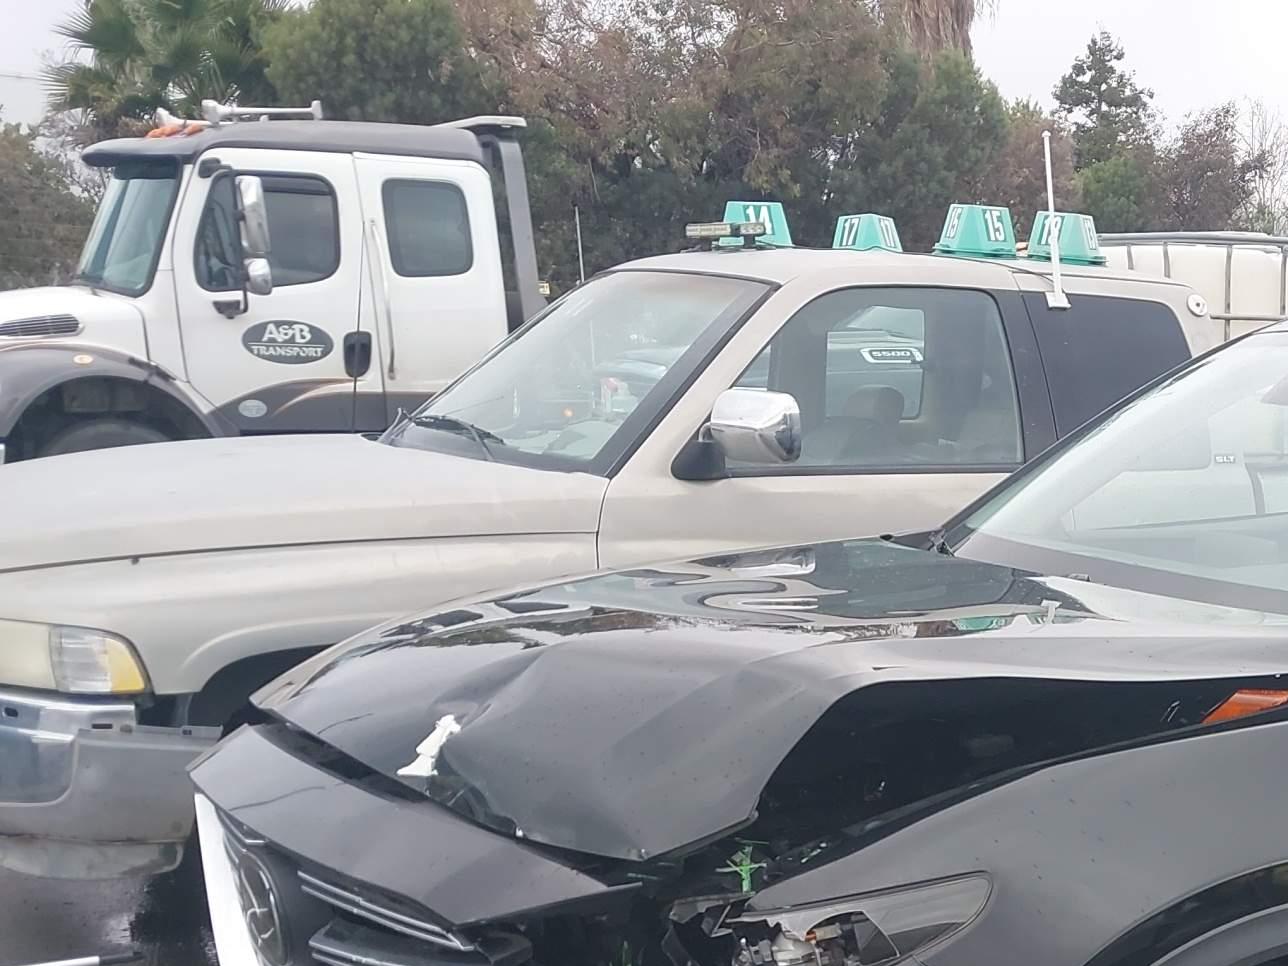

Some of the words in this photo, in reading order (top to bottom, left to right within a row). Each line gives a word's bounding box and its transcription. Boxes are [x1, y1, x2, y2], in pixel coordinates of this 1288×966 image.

[842, 217, 860, 247] 17
[984, 210, 1005, 242] 15
[261, 322, 312, 344] A&B
[249, 345, 325, 358] TRANSPORT
[1215, 455, 1235, 463] SLT
